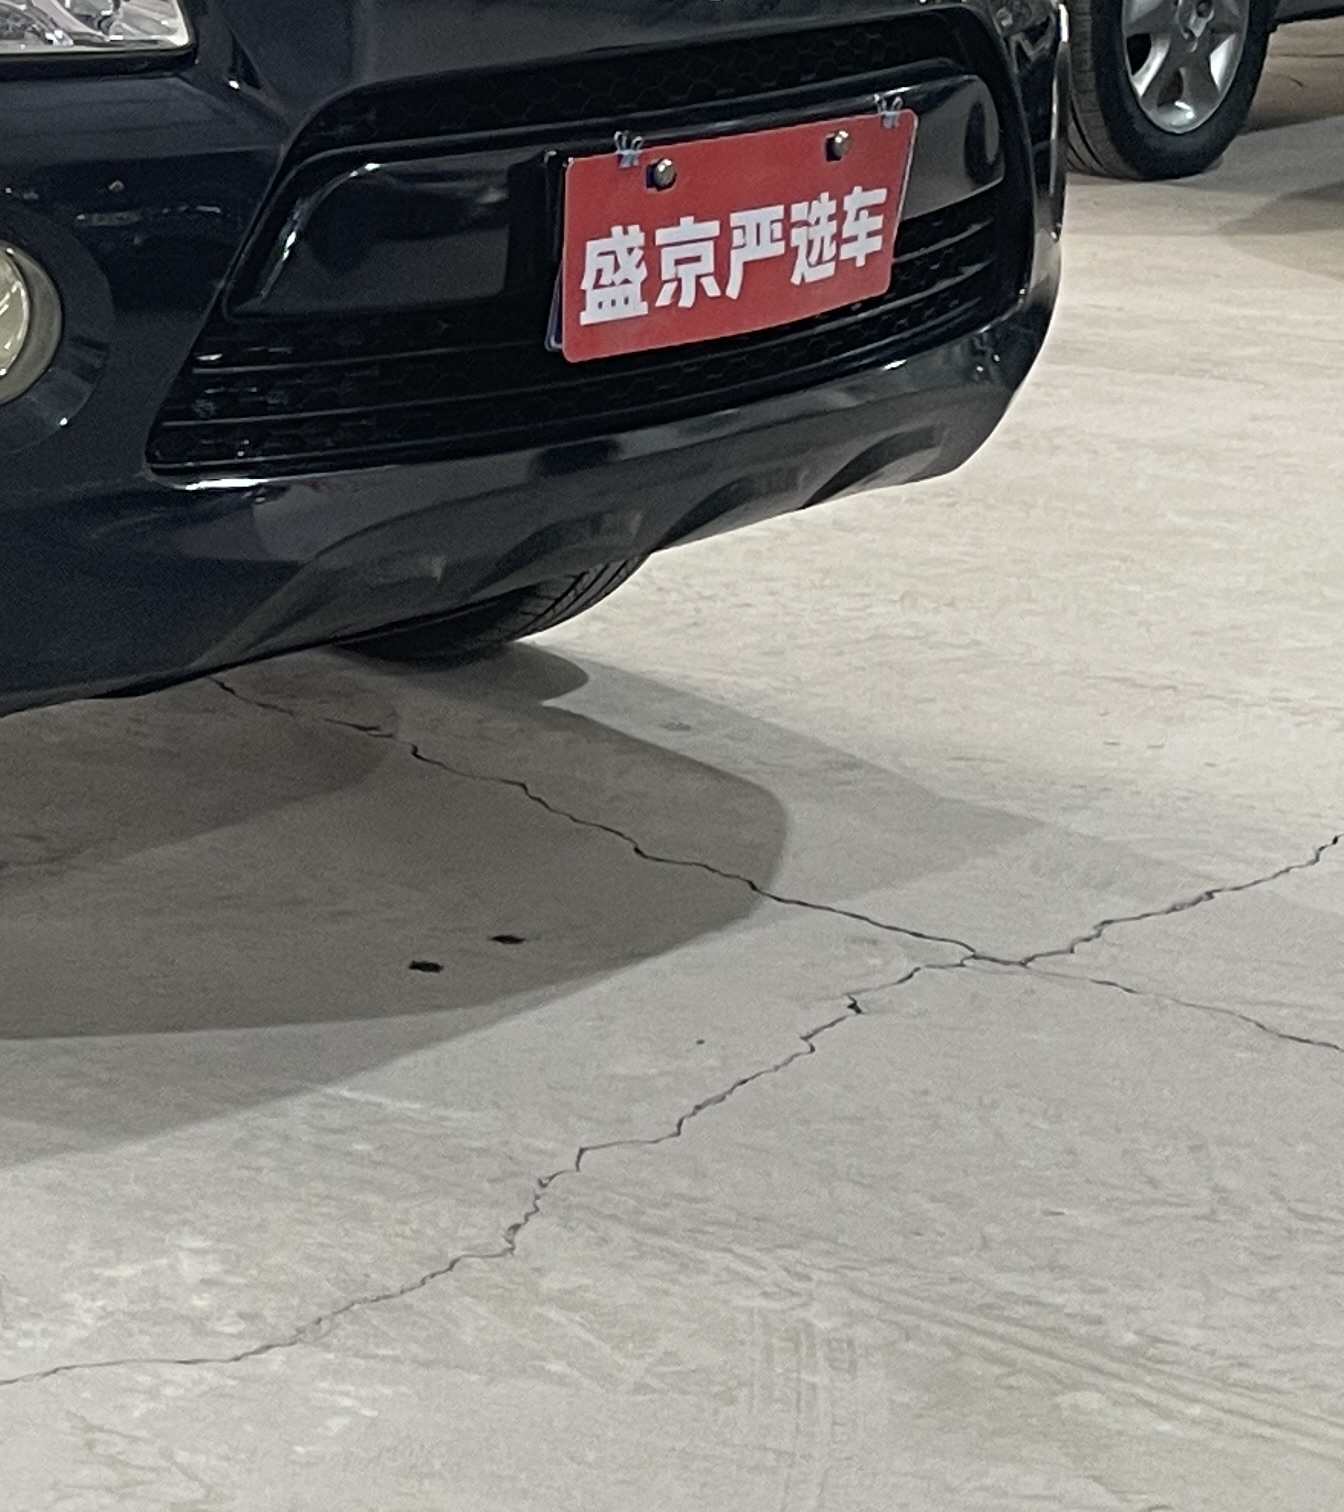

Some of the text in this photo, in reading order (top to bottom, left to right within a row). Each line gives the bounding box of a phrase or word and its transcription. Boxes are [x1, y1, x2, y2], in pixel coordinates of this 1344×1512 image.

[579, 185, 888, 326] 盛京严选车
